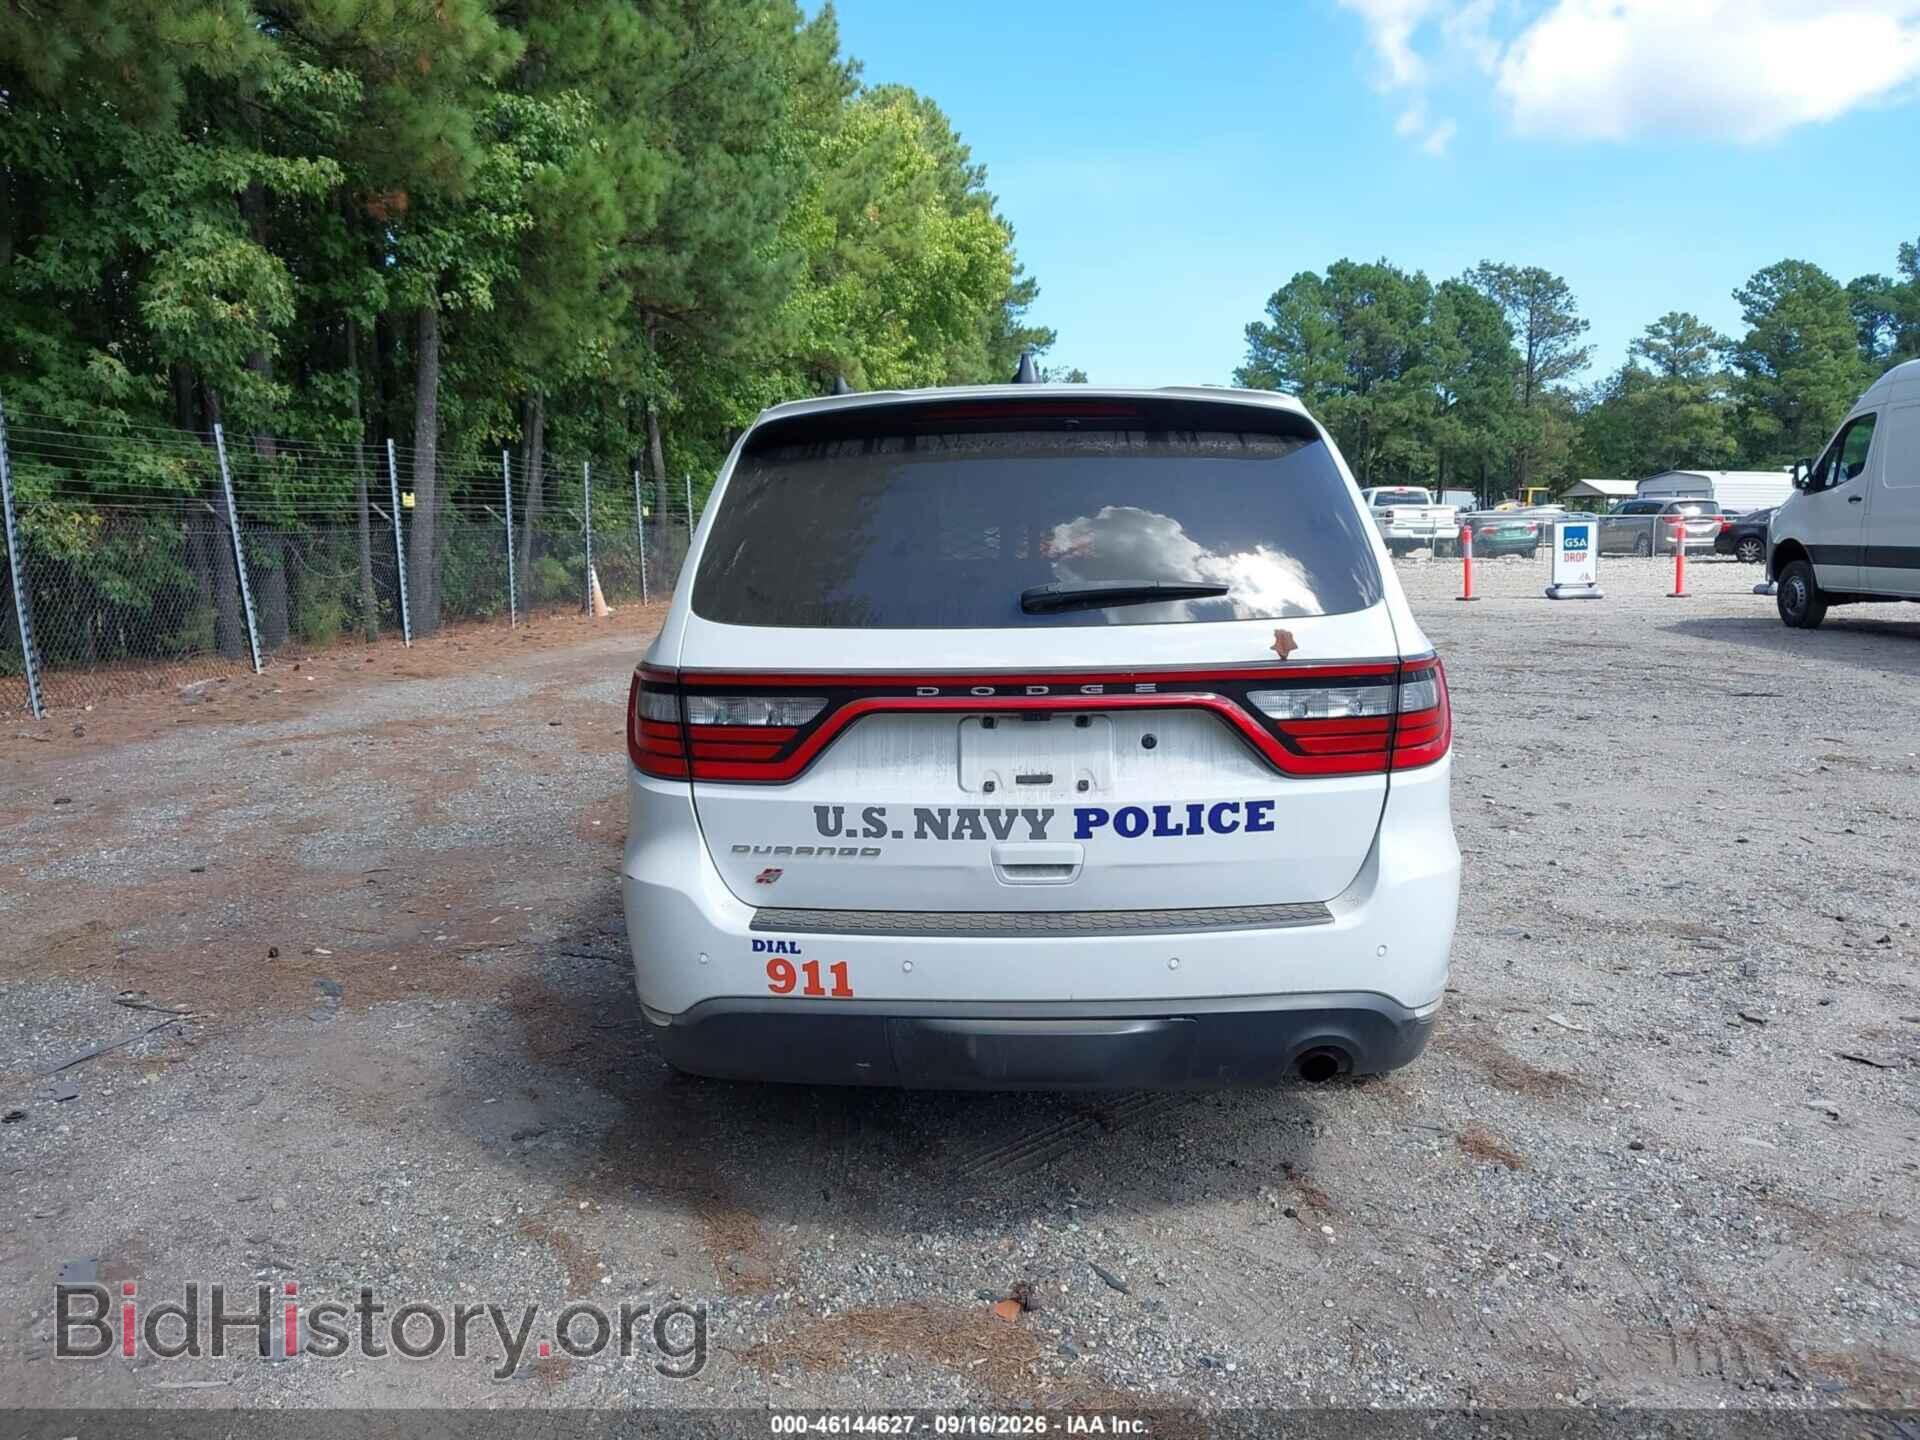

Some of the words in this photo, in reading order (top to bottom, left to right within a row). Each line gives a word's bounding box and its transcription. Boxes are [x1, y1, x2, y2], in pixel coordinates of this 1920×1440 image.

[1564, 537, 1587, 548] GSA
[1564, 552, 1588, 563] DROP
[916, 683, 1157, 696] DODGE
[813, 805, 904, 839] U.S.
[913, 807, 1055, 841] NAVY
[1073, 799, 1275, 840] POLICE
[731, 844, 882, 858] DURANGO
[751, 939, 802, 955] DIAL
[766, 957, 854, 998] 911
